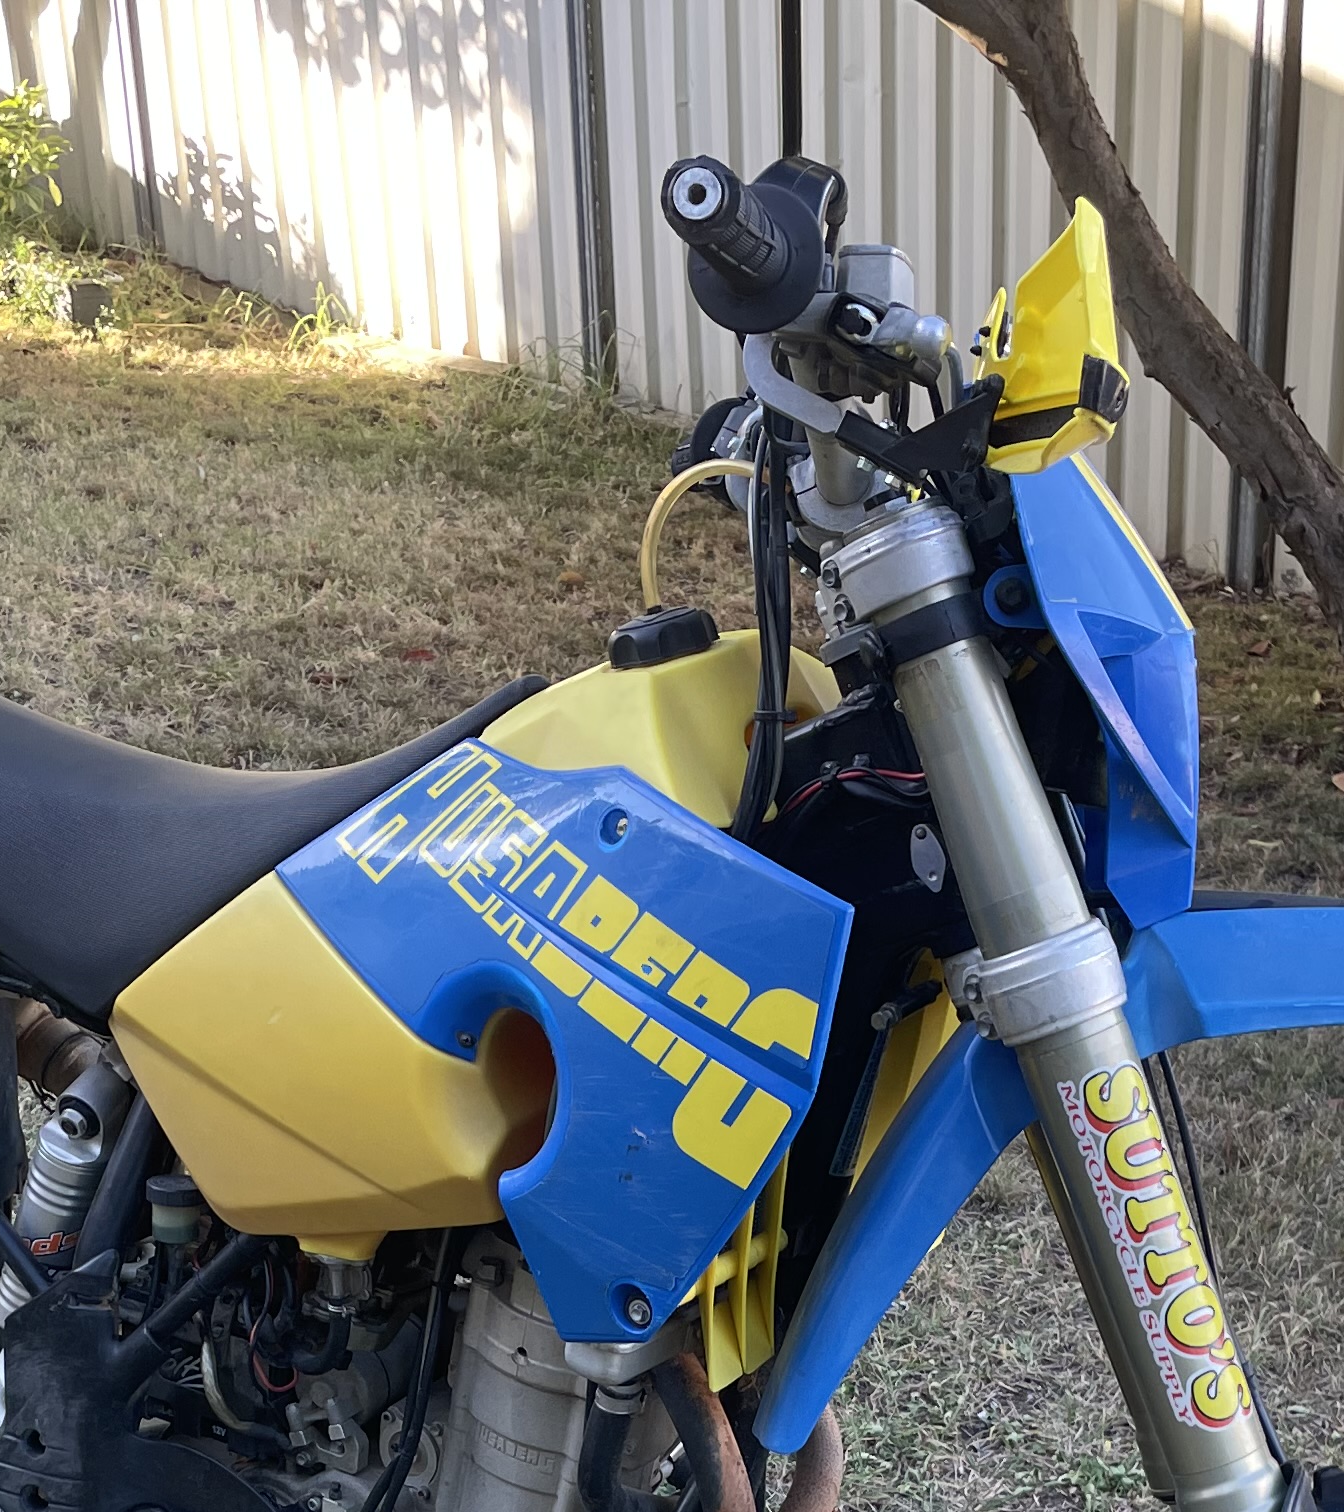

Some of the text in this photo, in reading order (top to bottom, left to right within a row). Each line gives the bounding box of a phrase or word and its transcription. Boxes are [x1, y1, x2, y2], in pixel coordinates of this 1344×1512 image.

[336, 742, 819, 1191] HUSABERG
[1058, 1083, 1194, 1425] MOTORCYCLE SUPPLY
